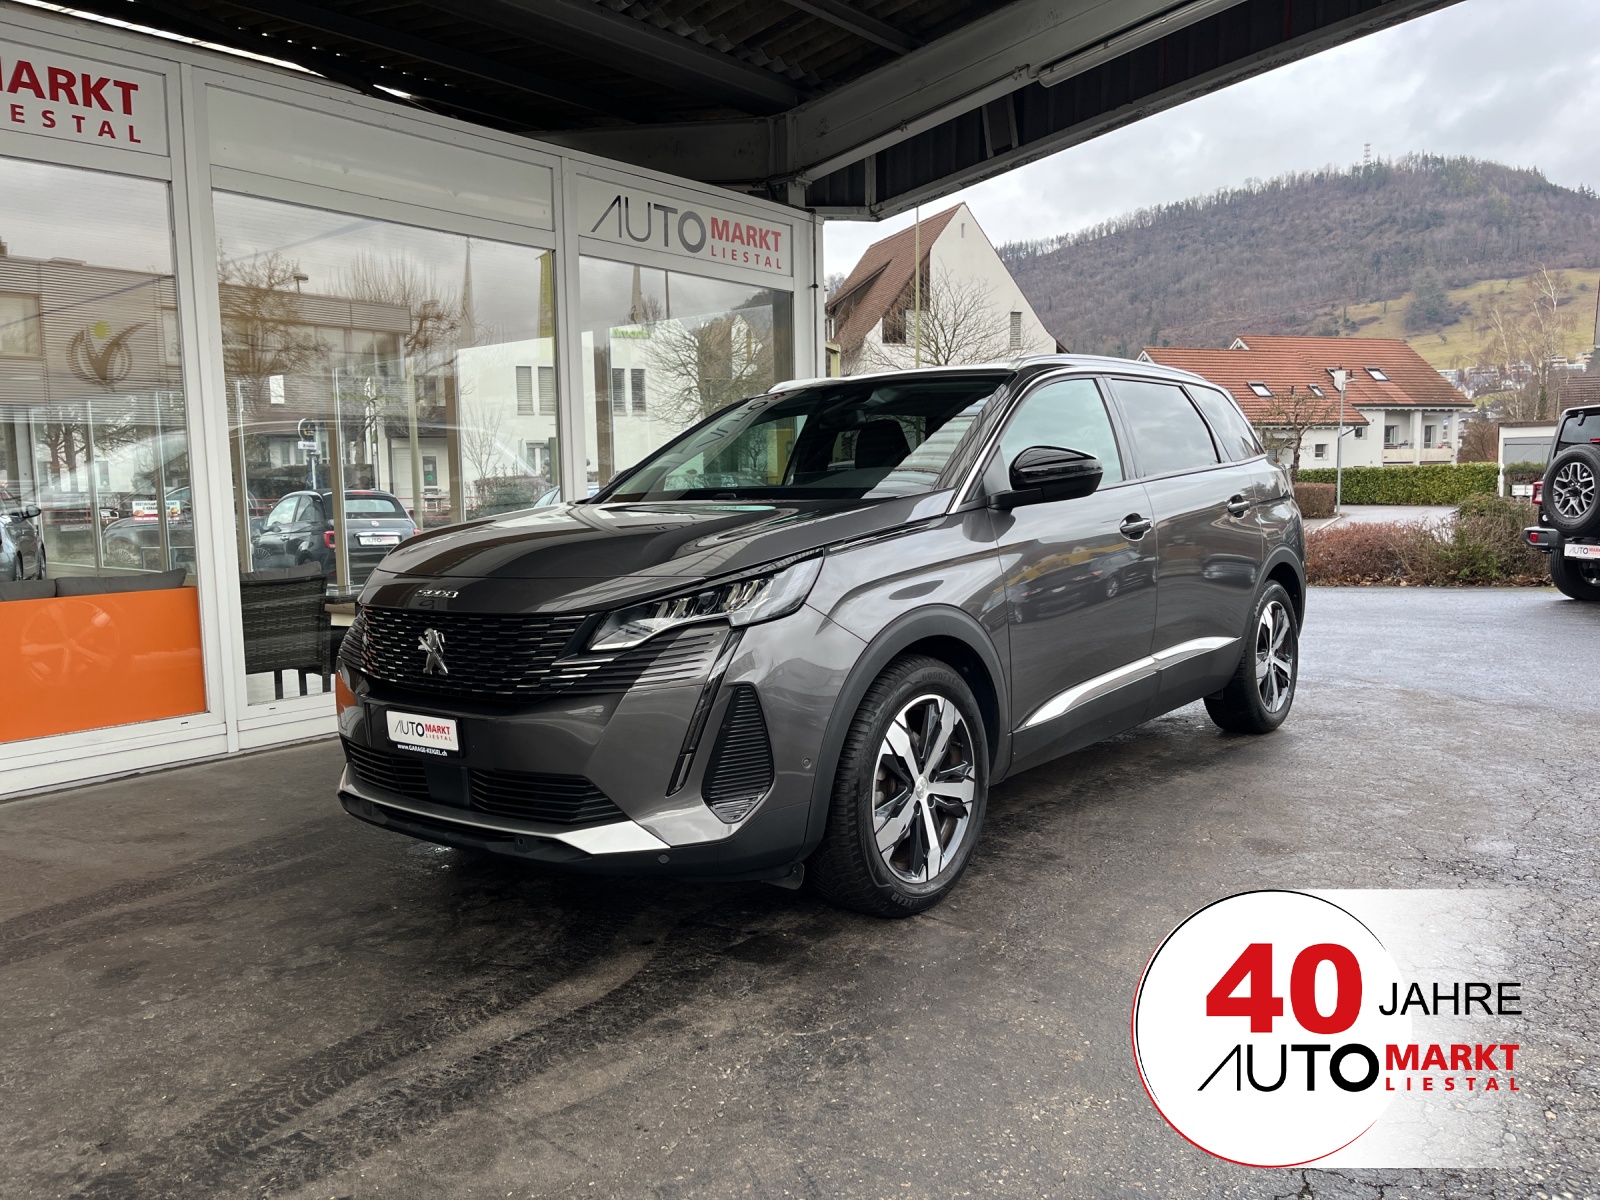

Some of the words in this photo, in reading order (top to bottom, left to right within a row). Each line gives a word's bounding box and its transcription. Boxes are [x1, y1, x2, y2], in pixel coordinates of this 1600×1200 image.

[0, 56, 139, 116] ARKT
[590, 194, 707, 254] AUTO
[710, 216, 782, 253] MARKT
[710, 244, 782, 270] LIESTAL
[394, 719, 425, 737] AUTO
[425, 723, 451, 735] MARKT
[425, 733, 452, 742] LIESTAL
